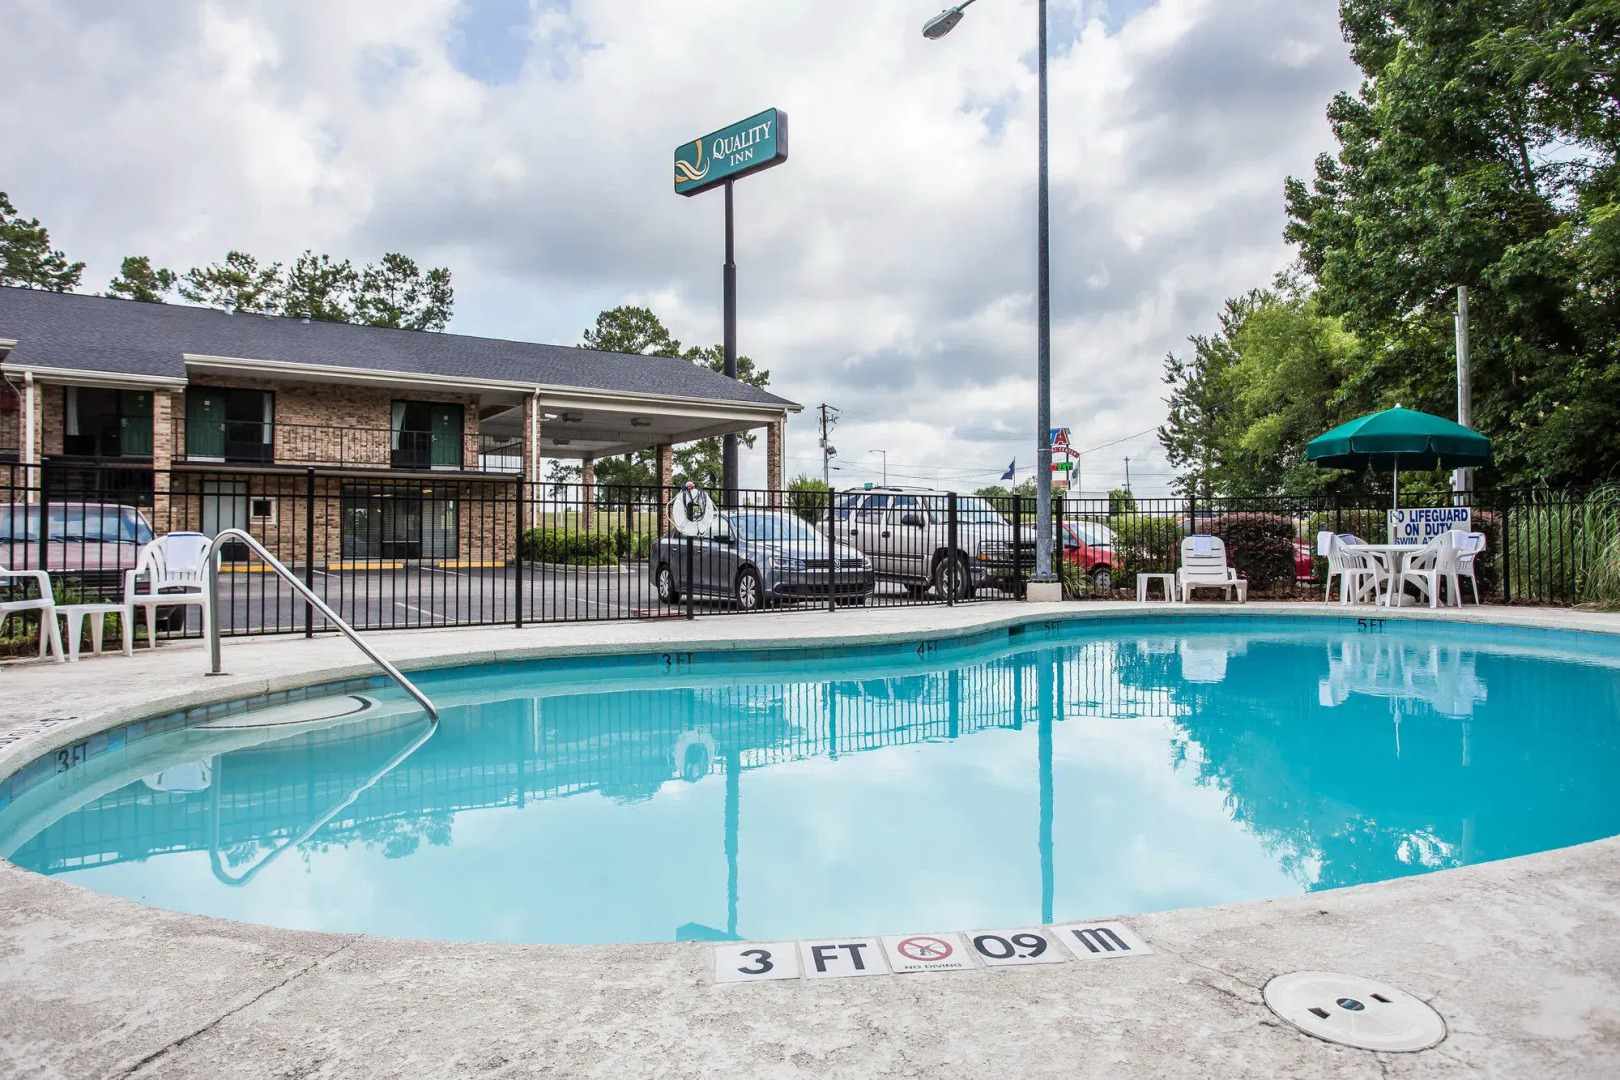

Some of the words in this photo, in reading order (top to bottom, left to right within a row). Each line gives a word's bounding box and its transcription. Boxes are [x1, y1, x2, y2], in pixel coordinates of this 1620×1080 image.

[713, 121, 771, 159] QUALITY
[730, 148, 755, 166] INN
[1410, 509, 1468, 522] LIFEGUARD
[1405, 523, 1419, 536] ON
[1358, 619, 1367, 630] 5
[1370, 619, 1385, 629] FT
[917, 641, 924, 653] 4
[927, 641, 938, 651] FT
[662, 653, 671, 665] 3
[676, 652, 694, 664] FT
[58, 749, 69, 773] 3
[73, 741, 89, 766] FT
[973, 933, 1048, 958] 0.9
[1072, 926, 1131, 953] m
[737, 948, 774, 975] 3
[812, 943, 868, 973] FT
